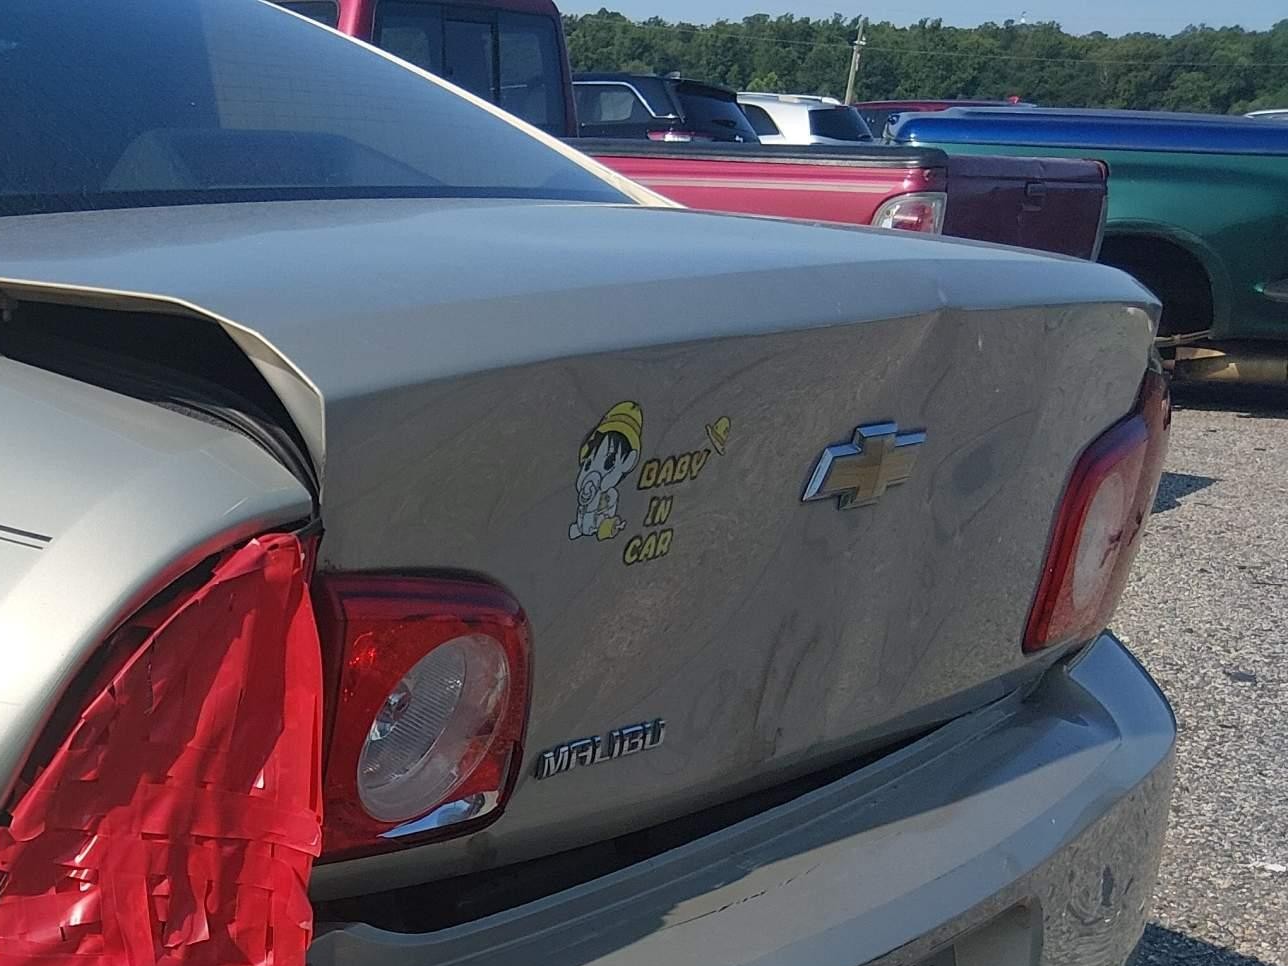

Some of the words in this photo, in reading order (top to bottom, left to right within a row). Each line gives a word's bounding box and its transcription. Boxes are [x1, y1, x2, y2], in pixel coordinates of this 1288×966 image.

[636, 449, 710, 490] BABY
[643, 496, 674, 527] IN
[623, 528, 674, 566] CAR
[534, 718, 666, 780] MALIBU
